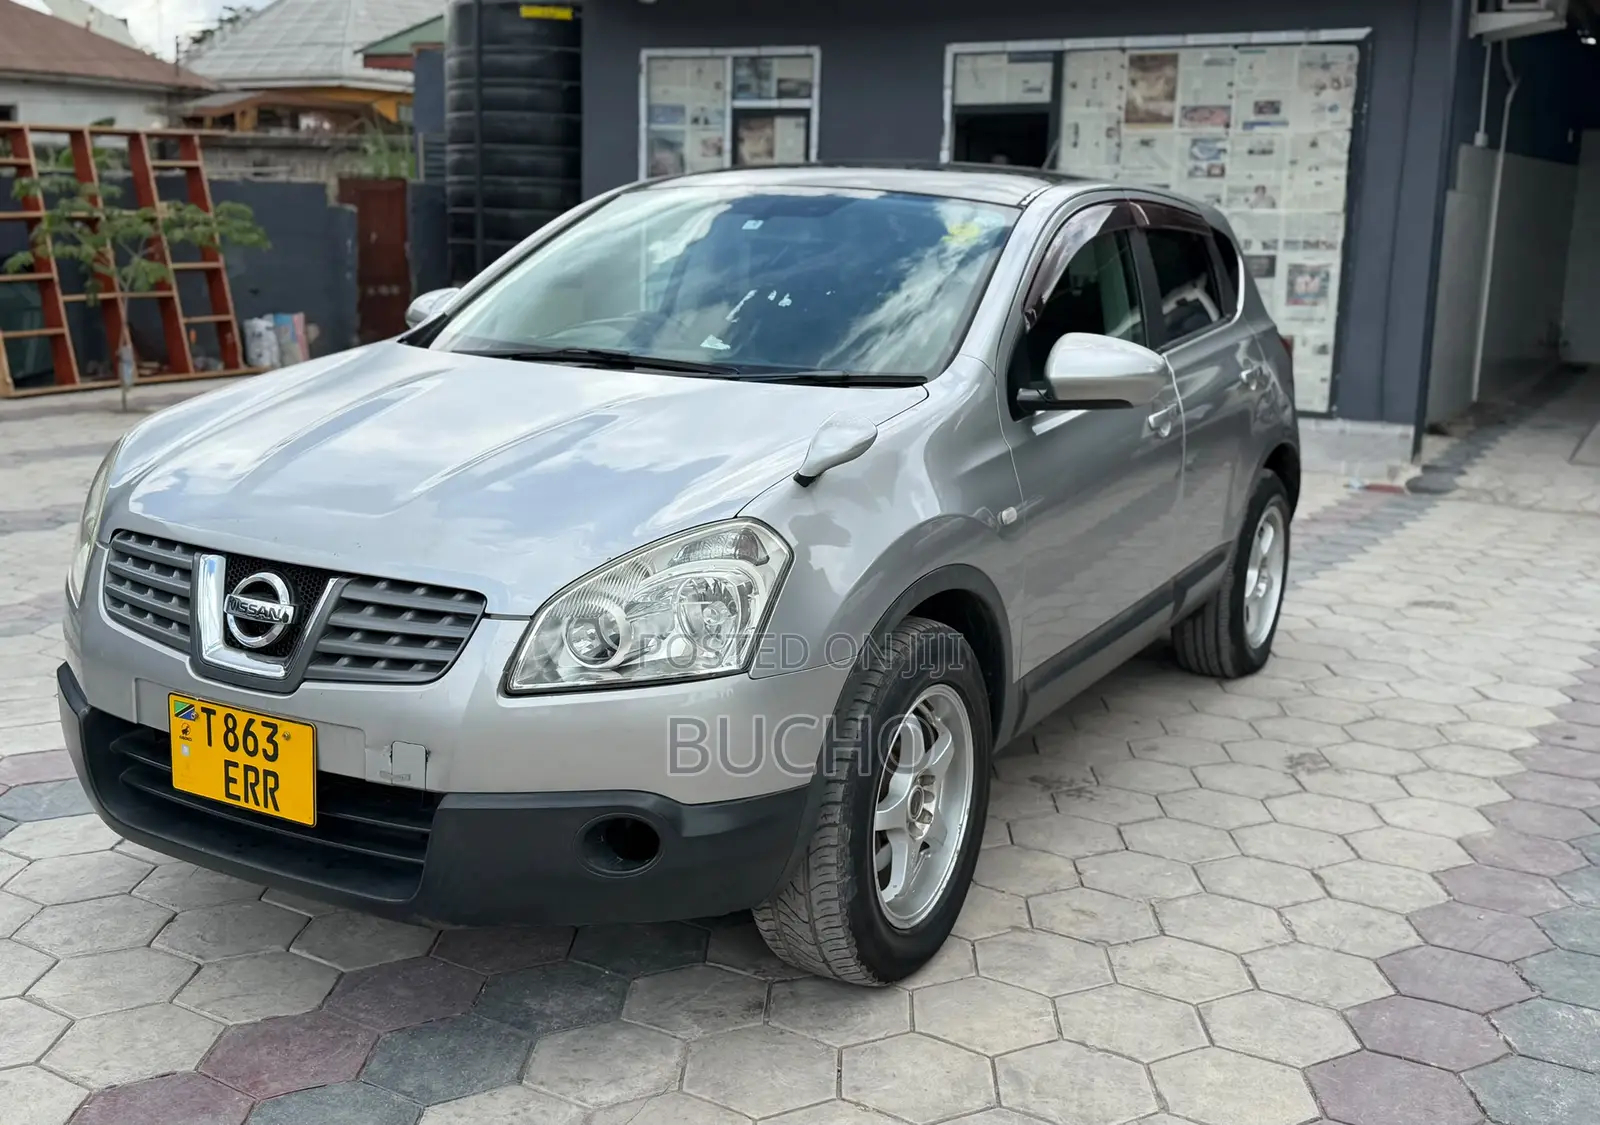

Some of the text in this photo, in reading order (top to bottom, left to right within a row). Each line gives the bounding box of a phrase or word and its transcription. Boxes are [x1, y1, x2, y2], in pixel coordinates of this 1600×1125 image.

[228, 596, 282, 621] NISSAN
[201, 706, 279, 762] T 863
[224, 759, 280, 812] ERR
